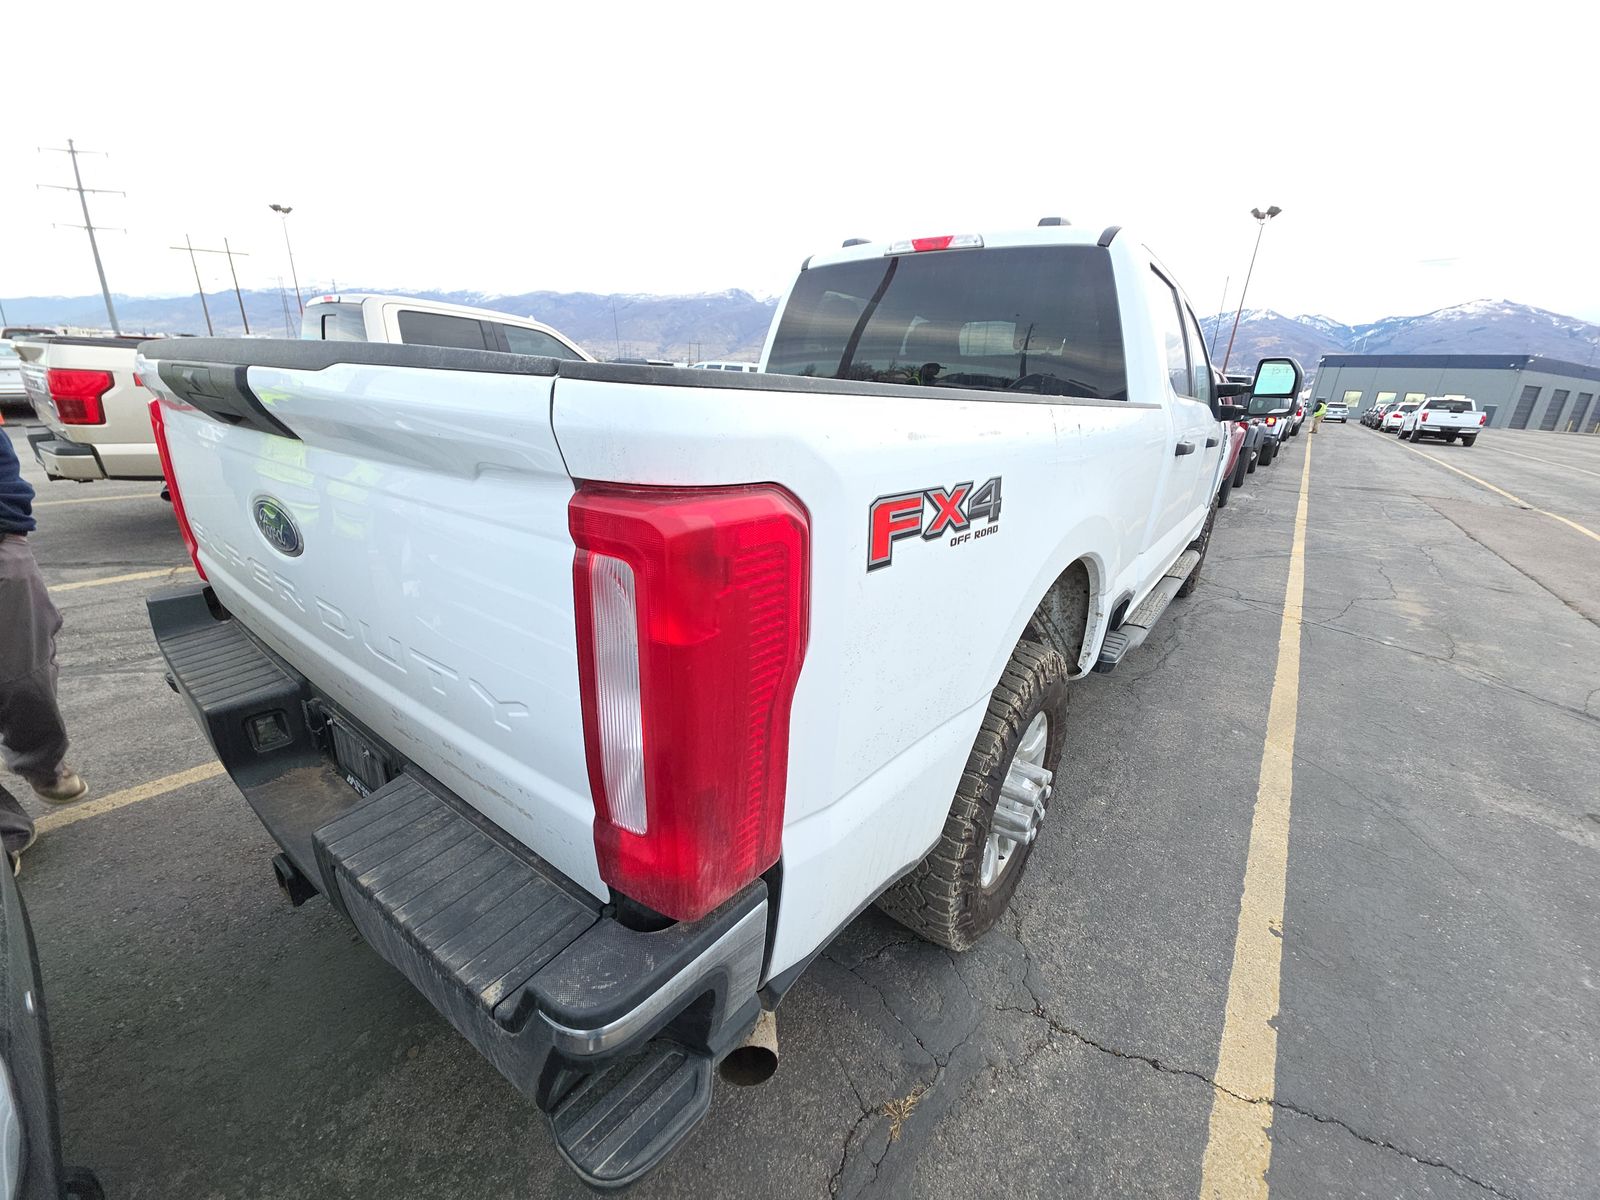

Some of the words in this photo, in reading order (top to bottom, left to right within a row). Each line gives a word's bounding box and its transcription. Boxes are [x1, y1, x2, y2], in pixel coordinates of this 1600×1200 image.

[258, 507, 286, 546] Ford
[867, 475, 1002, 574] FX4
[950, 534, 972, 547] OFF
[974, 525, 999, 540] ROAD
[192, 519, 306, 613] SUPER
[315, 595, 530, 732] DUTY
